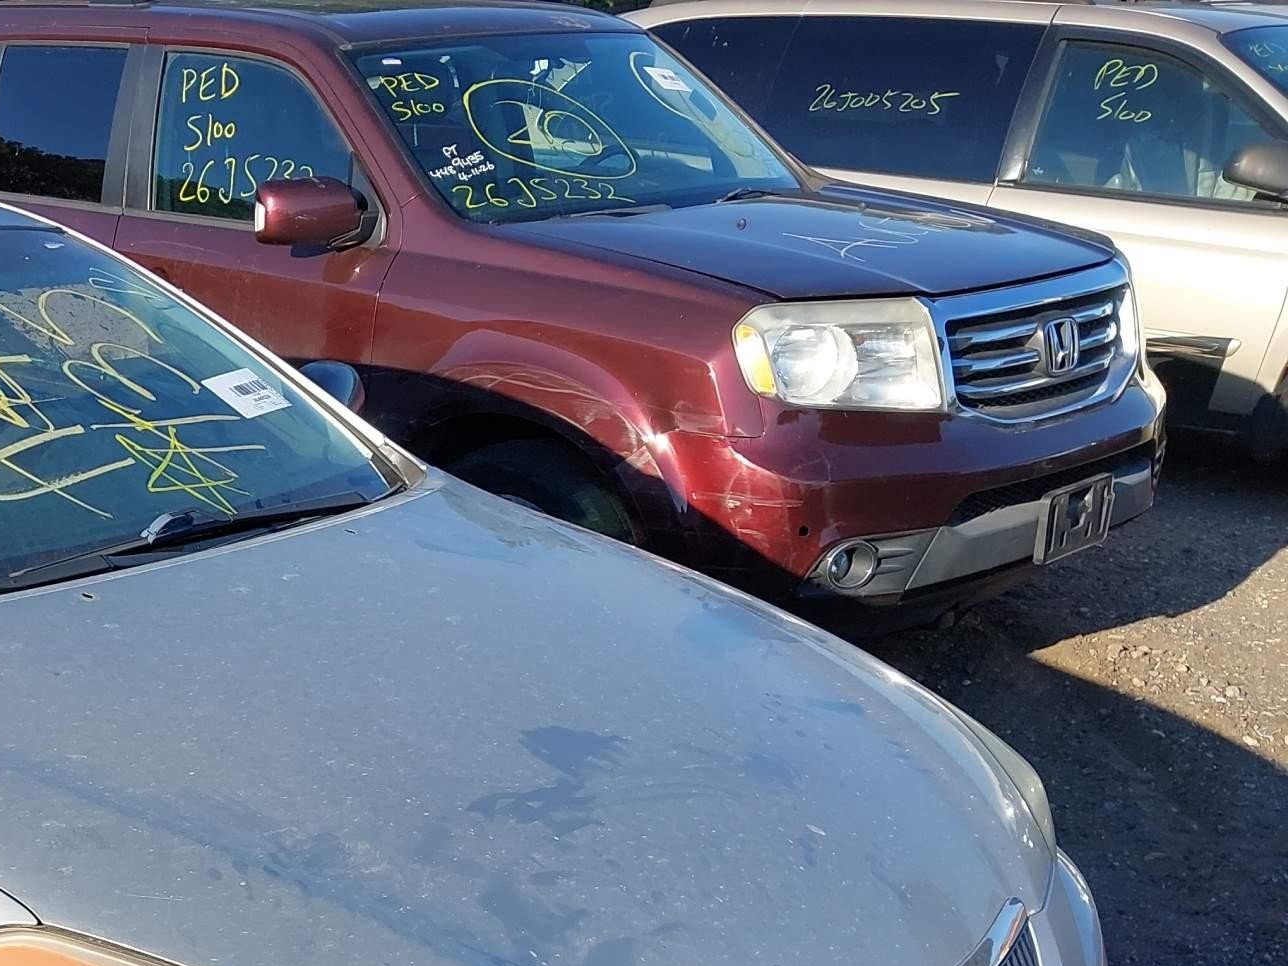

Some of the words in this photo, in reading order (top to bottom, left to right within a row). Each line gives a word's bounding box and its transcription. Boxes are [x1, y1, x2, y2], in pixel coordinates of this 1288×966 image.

[181, 62, 239, 103] PED
[379, 73, 440, 98] PED
[1094, 59, 1158, 90] PED
